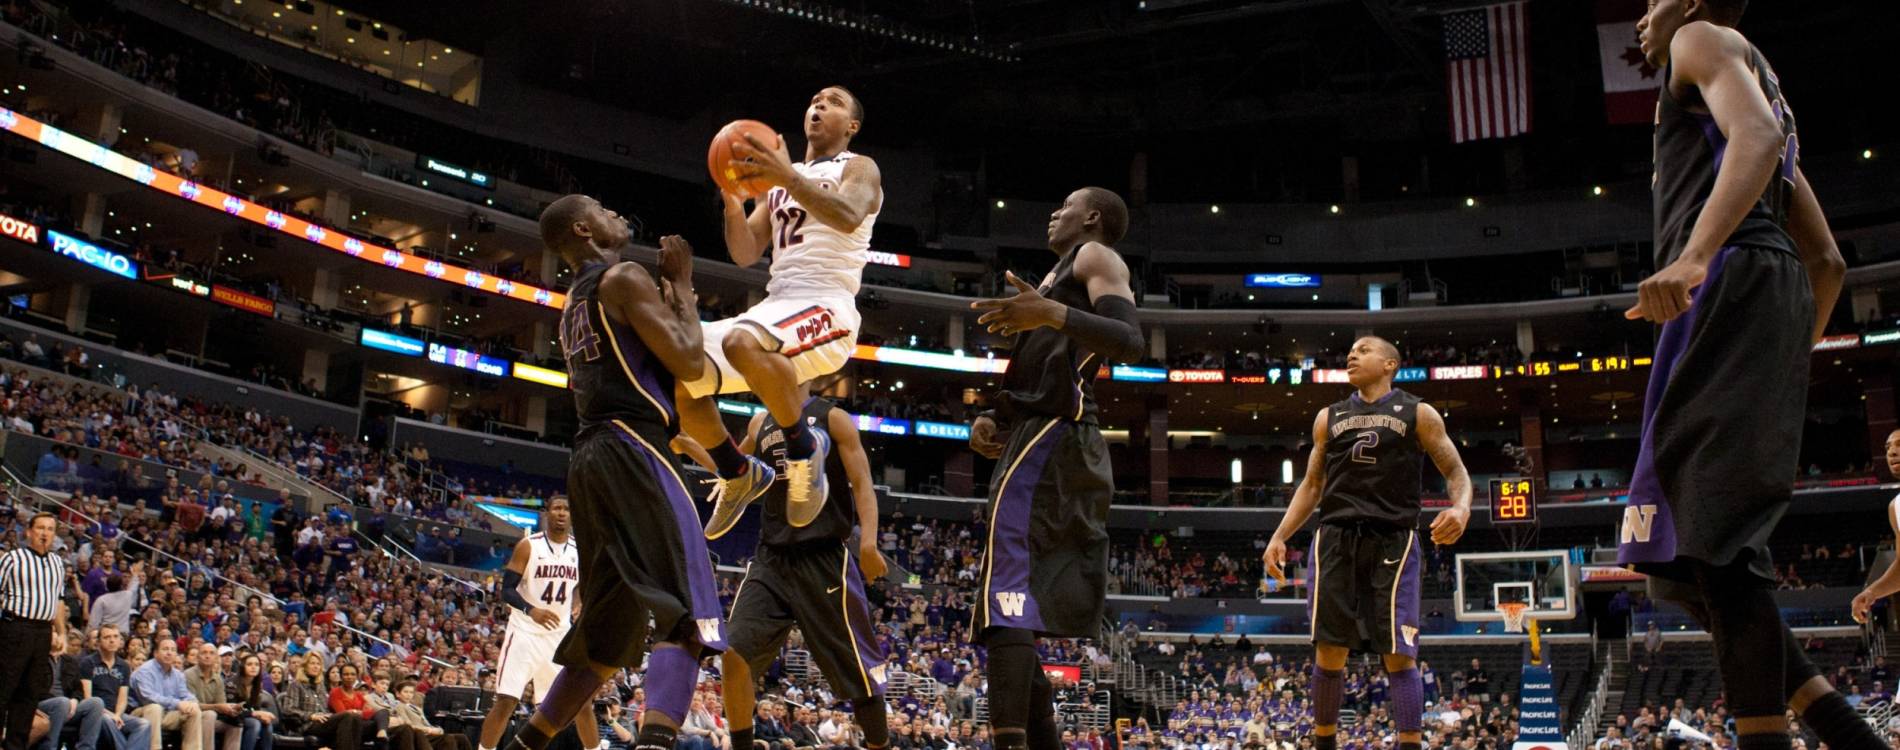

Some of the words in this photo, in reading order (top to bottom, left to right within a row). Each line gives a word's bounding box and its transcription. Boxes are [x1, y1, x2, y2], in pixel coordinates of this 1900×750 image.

[775, 207, 807, 248] 12
[213, 287, 243, 304] WELLS
[244, 298, 273, 313] FARGO
[1185, 370, 1223, 381] TOYOTA
[1434, 366, 1483, 379] STAPLES
[1534, 362, 1550, 376] 55
[930, 424, 969, 437] DELTA
[1331, 414, 1407, 438] WASHINGTON
[1352, 430, 1379, 464] 2
[1501, 481, 1530, 496] 6:19
[1500, 496, 1527, 518] 28
[1621, 504, 1657, 544] W
[534, 564, 577, 580] ARIZONA
[541, 580, 567, 605] 44
[996, 591, 1026, 617] W
[695, 617, 721, 642] W
[1401, 624, 1419, 647] W
